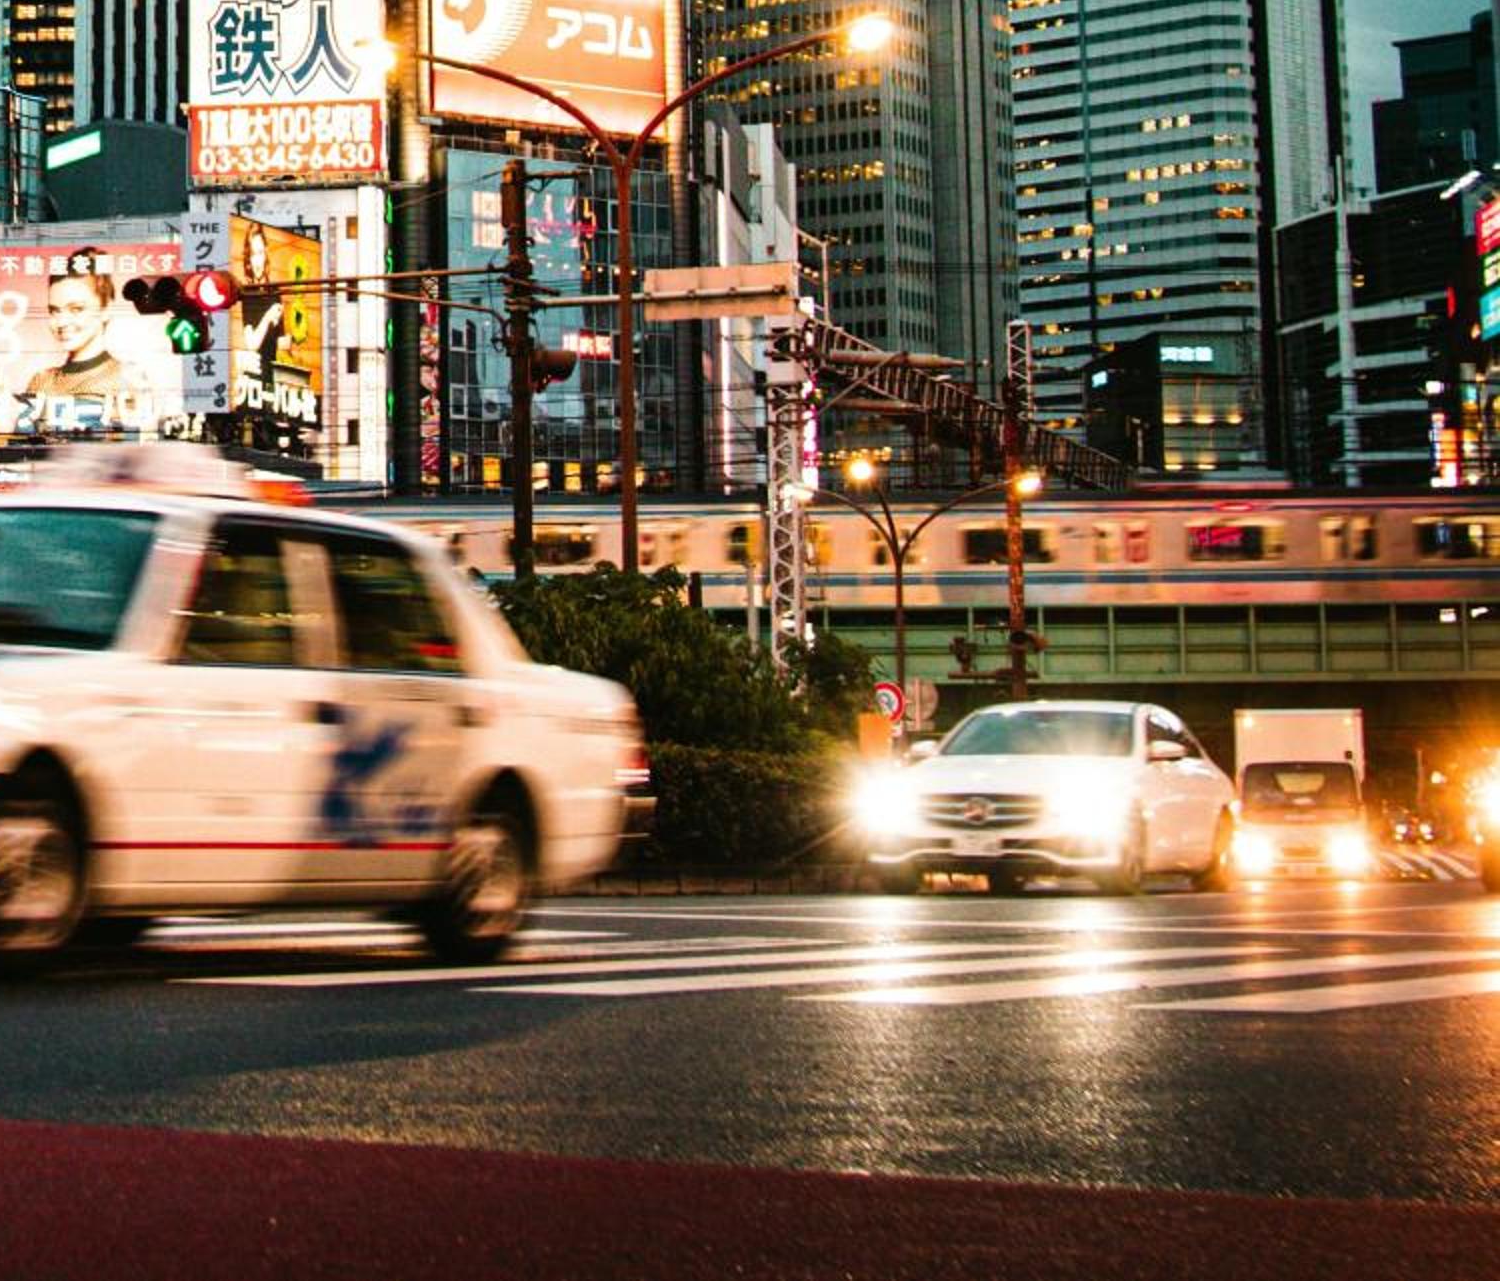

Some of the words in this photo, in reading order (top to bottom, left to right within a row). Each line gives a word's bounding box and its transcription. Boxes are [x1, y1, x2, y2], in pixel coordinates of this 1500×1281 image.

[210, 1, 355, 89] 鉄人
[545, 5, 655, 61] アコム
[199, 142, 376, 174] 03-3345-6430
[190, 222, 220, 234] THE
